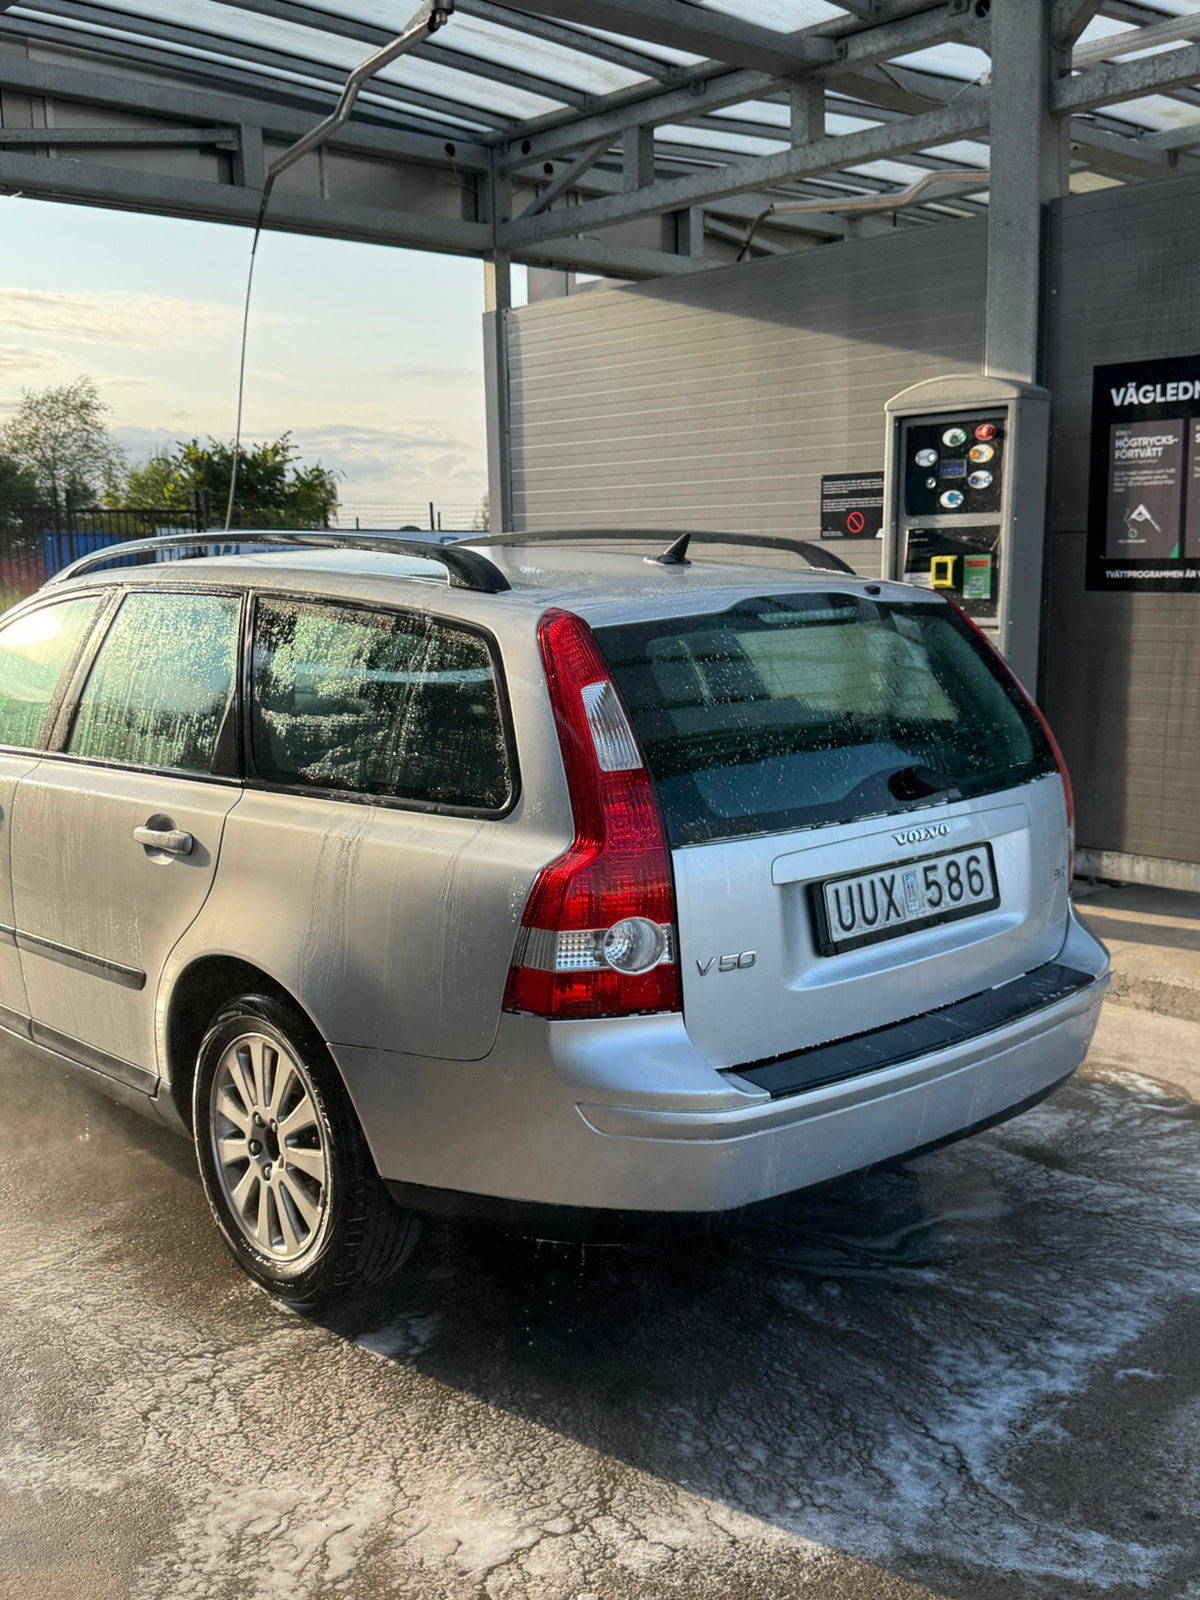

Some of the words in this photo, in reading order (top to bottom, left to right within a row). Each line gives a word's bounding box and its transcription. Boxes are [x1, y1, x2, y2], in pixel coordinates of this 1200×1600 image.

[1115, 435, 1179, 448] HÖGTRYCKS-
[1114, 447, 1164, 459] FÖRTVÄTT
[1105, 569, 1184, 579] TVÄTTPROGRAMMEN
[1185, 568, 1197, 578] ÄR
[893, 823, 950, 846] VOLVO
[834, 874, 901, 932] UUX
[922, 855, 985, 908] 586
[696, 950, 757, 976] V50
